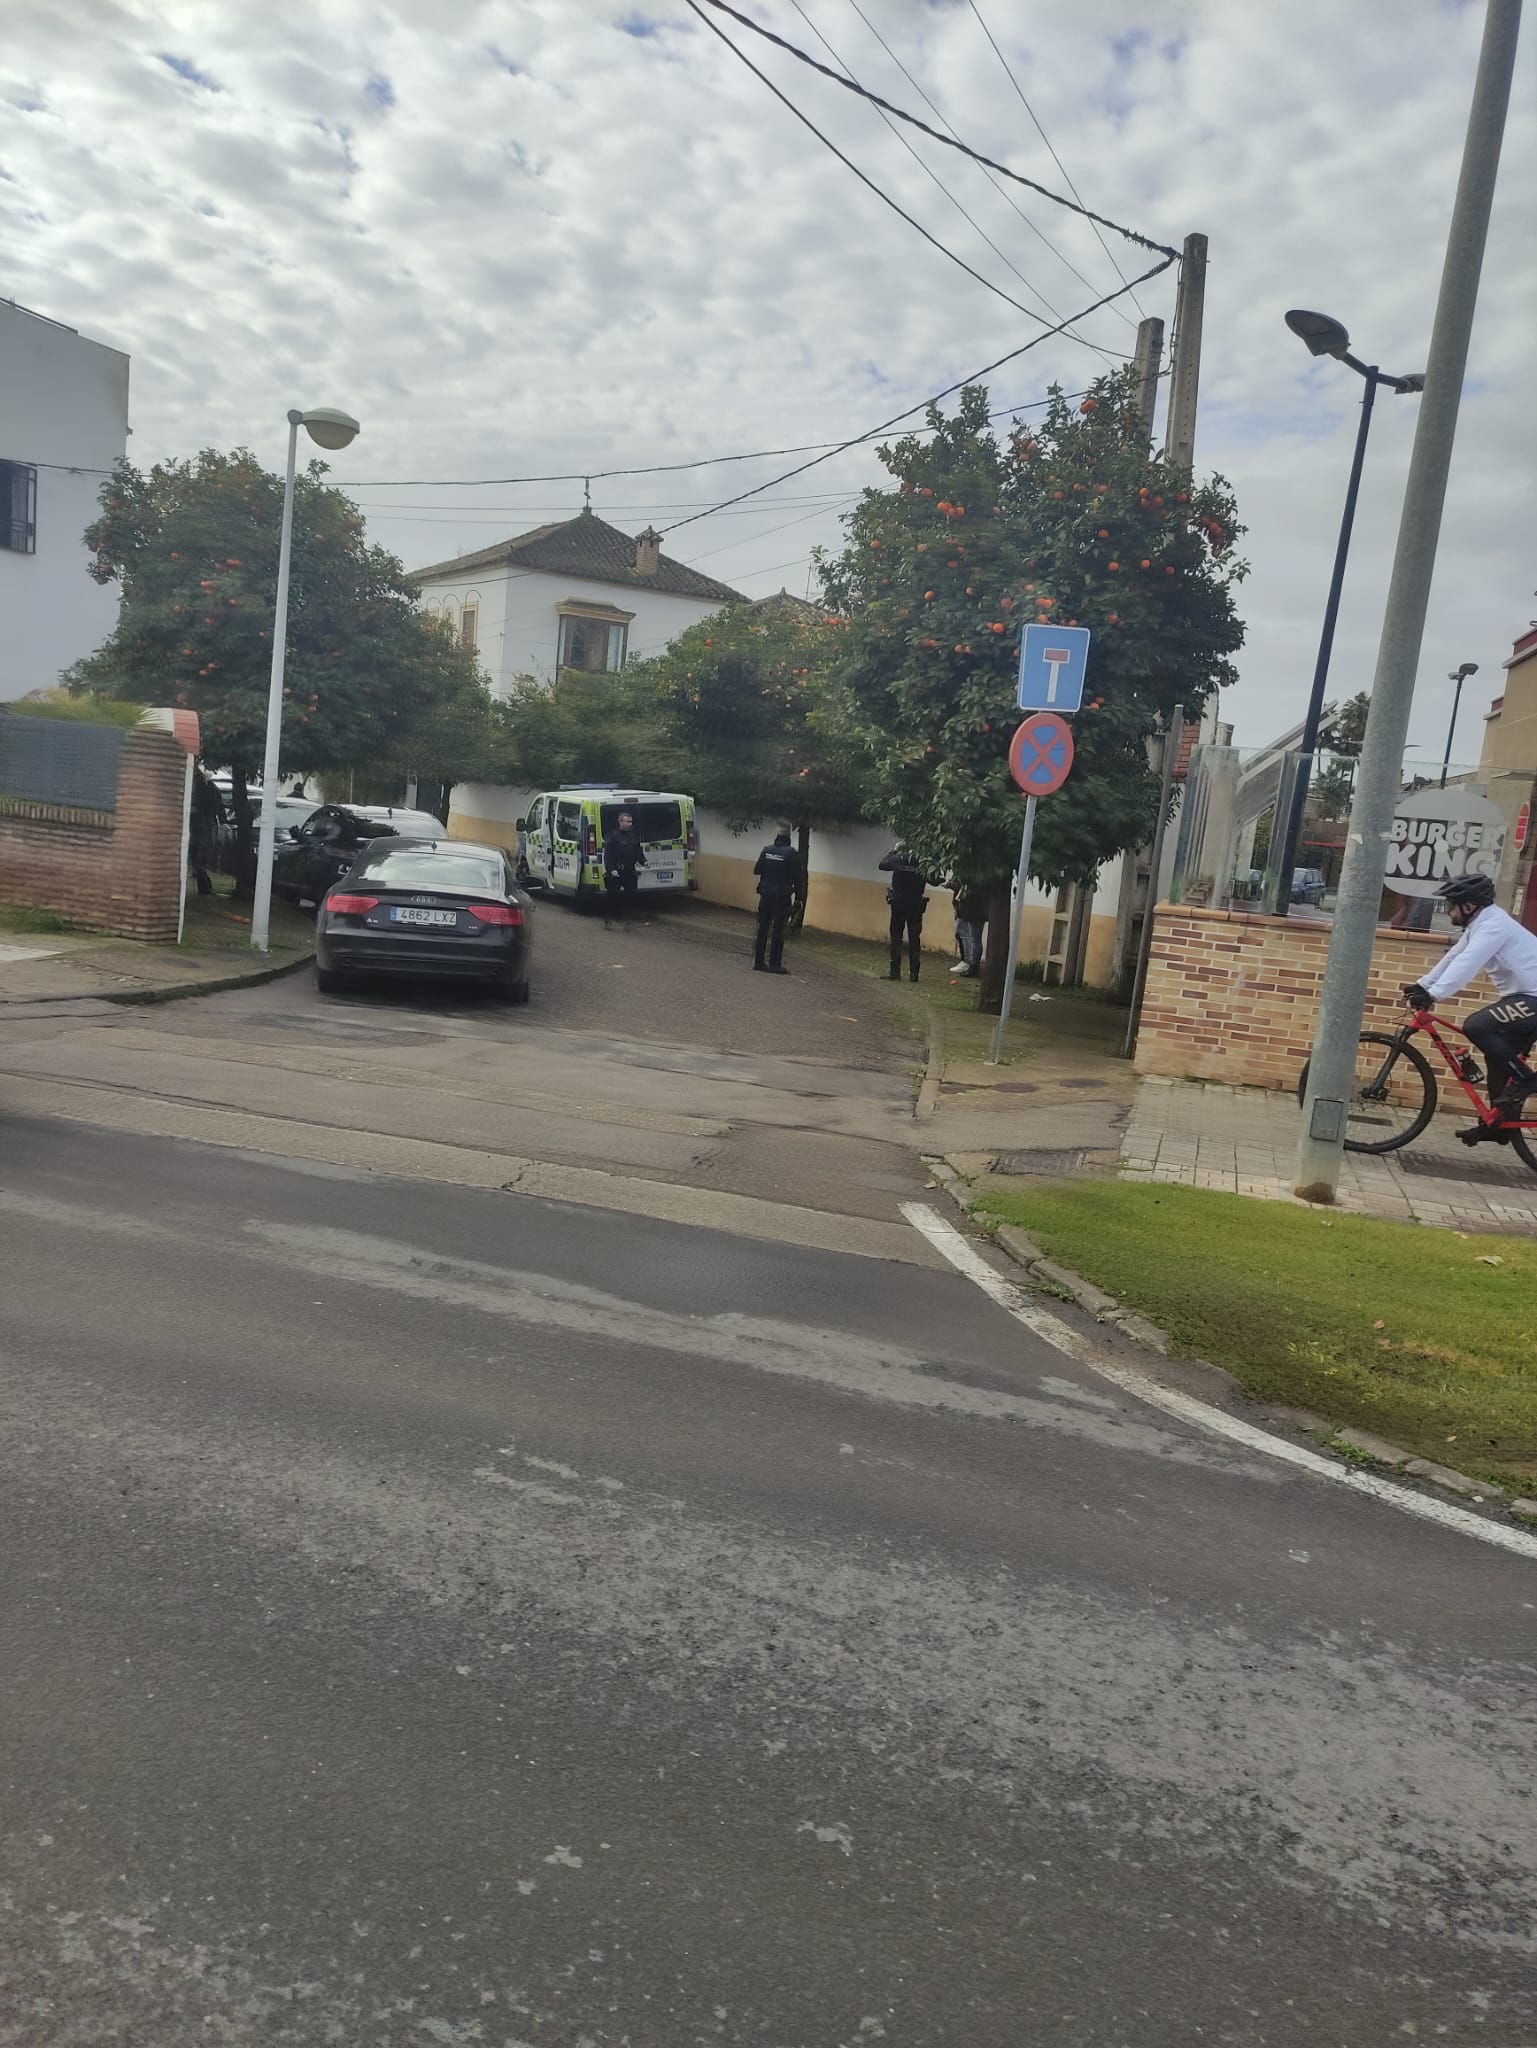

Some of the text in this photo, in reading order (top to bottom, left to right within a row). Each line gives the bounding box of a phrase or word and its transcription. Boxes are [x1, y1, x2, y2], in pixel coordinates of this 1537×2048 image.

[1391, 819, 1501, 850] BURGER
[1386, 843, 1499, 878] KING
[401, 909, 455, 923] 4862 LXZ
[1489, 1001, 1535, 1022] UAE
